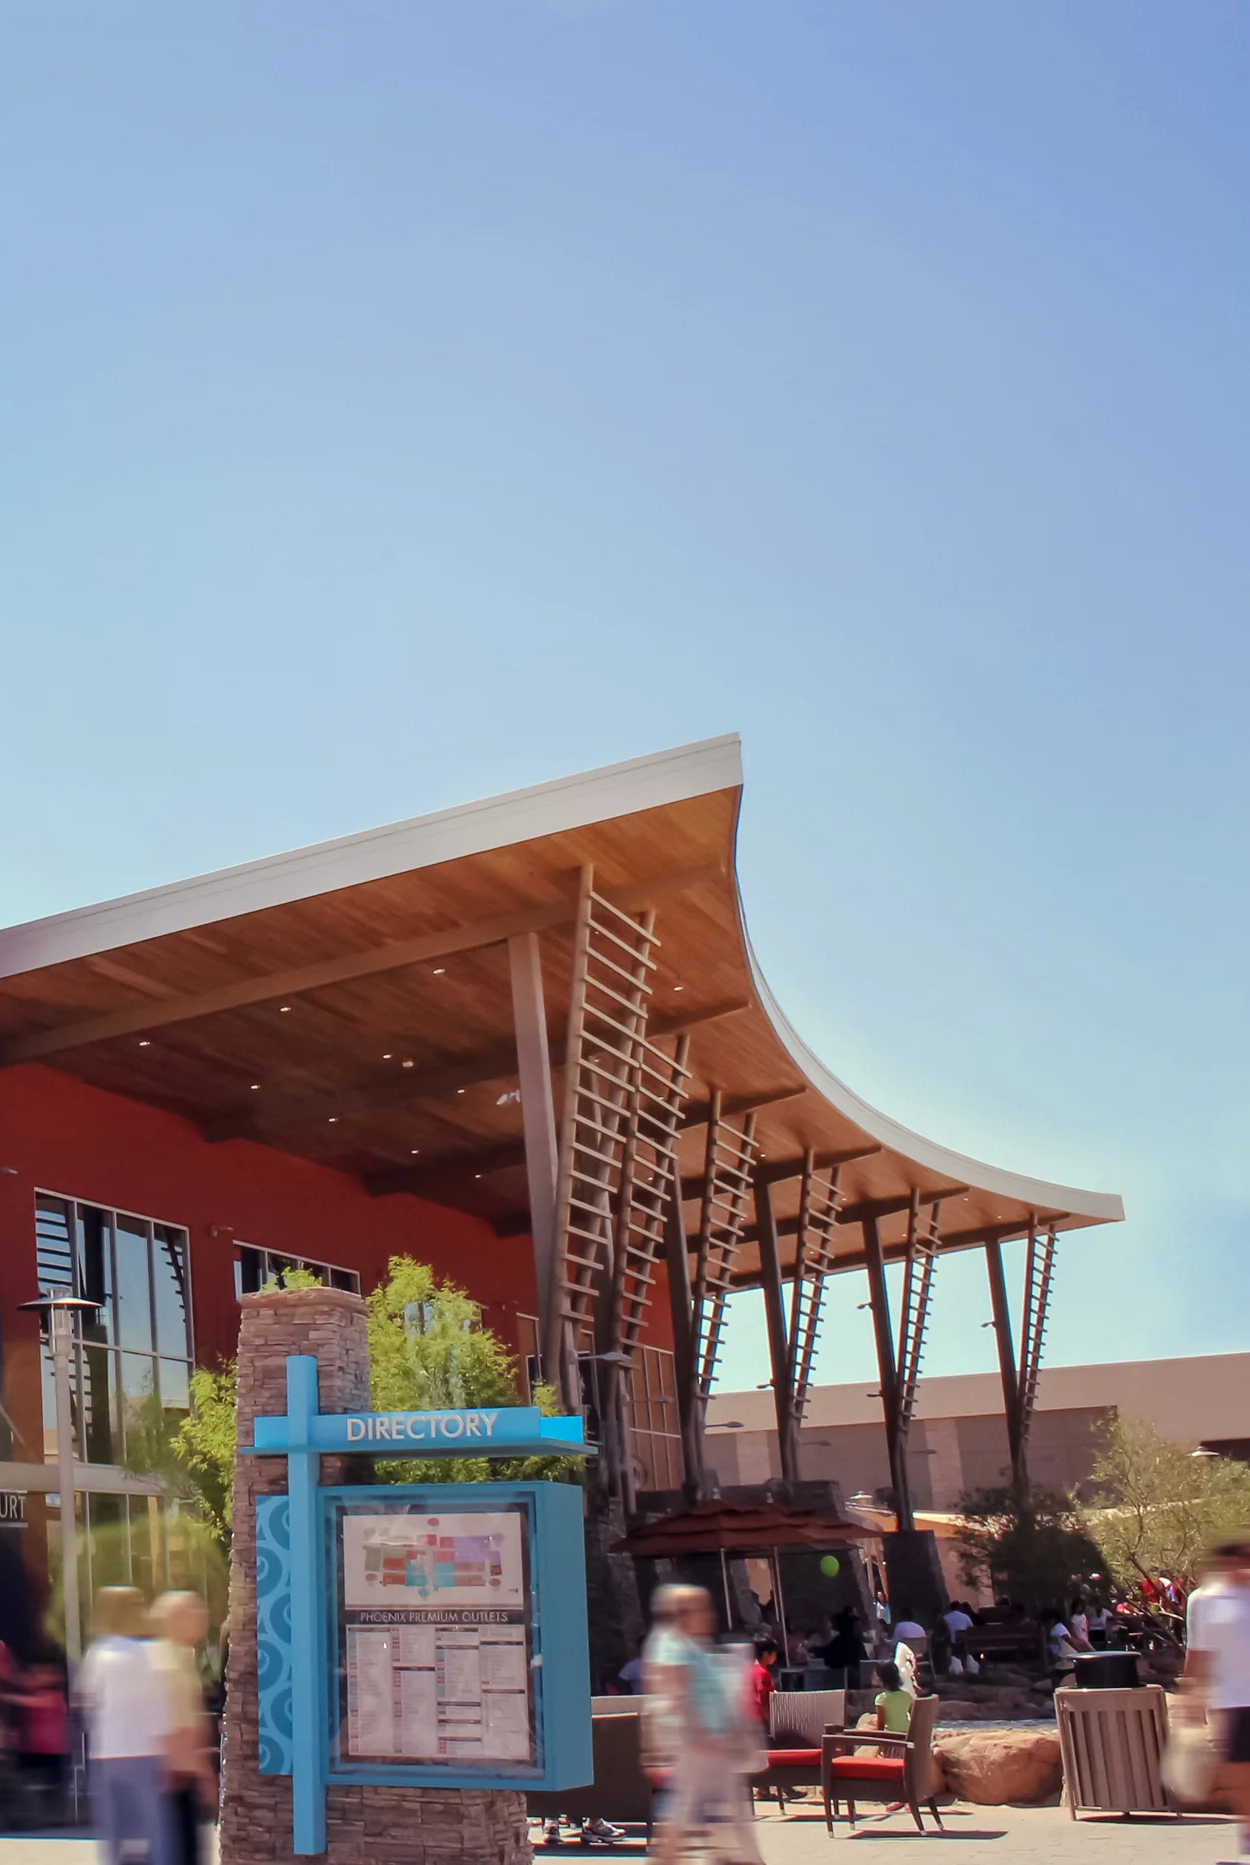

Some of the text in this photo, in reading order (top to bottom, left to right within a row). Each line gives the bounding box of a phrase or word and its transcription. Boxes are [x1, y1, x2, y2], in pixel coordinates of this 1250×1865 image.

[346, 1412, 498, 1441] DIRECTORY
[360, 1611, 508, 1622] PHOENIX PREMIUM OUTLETS
